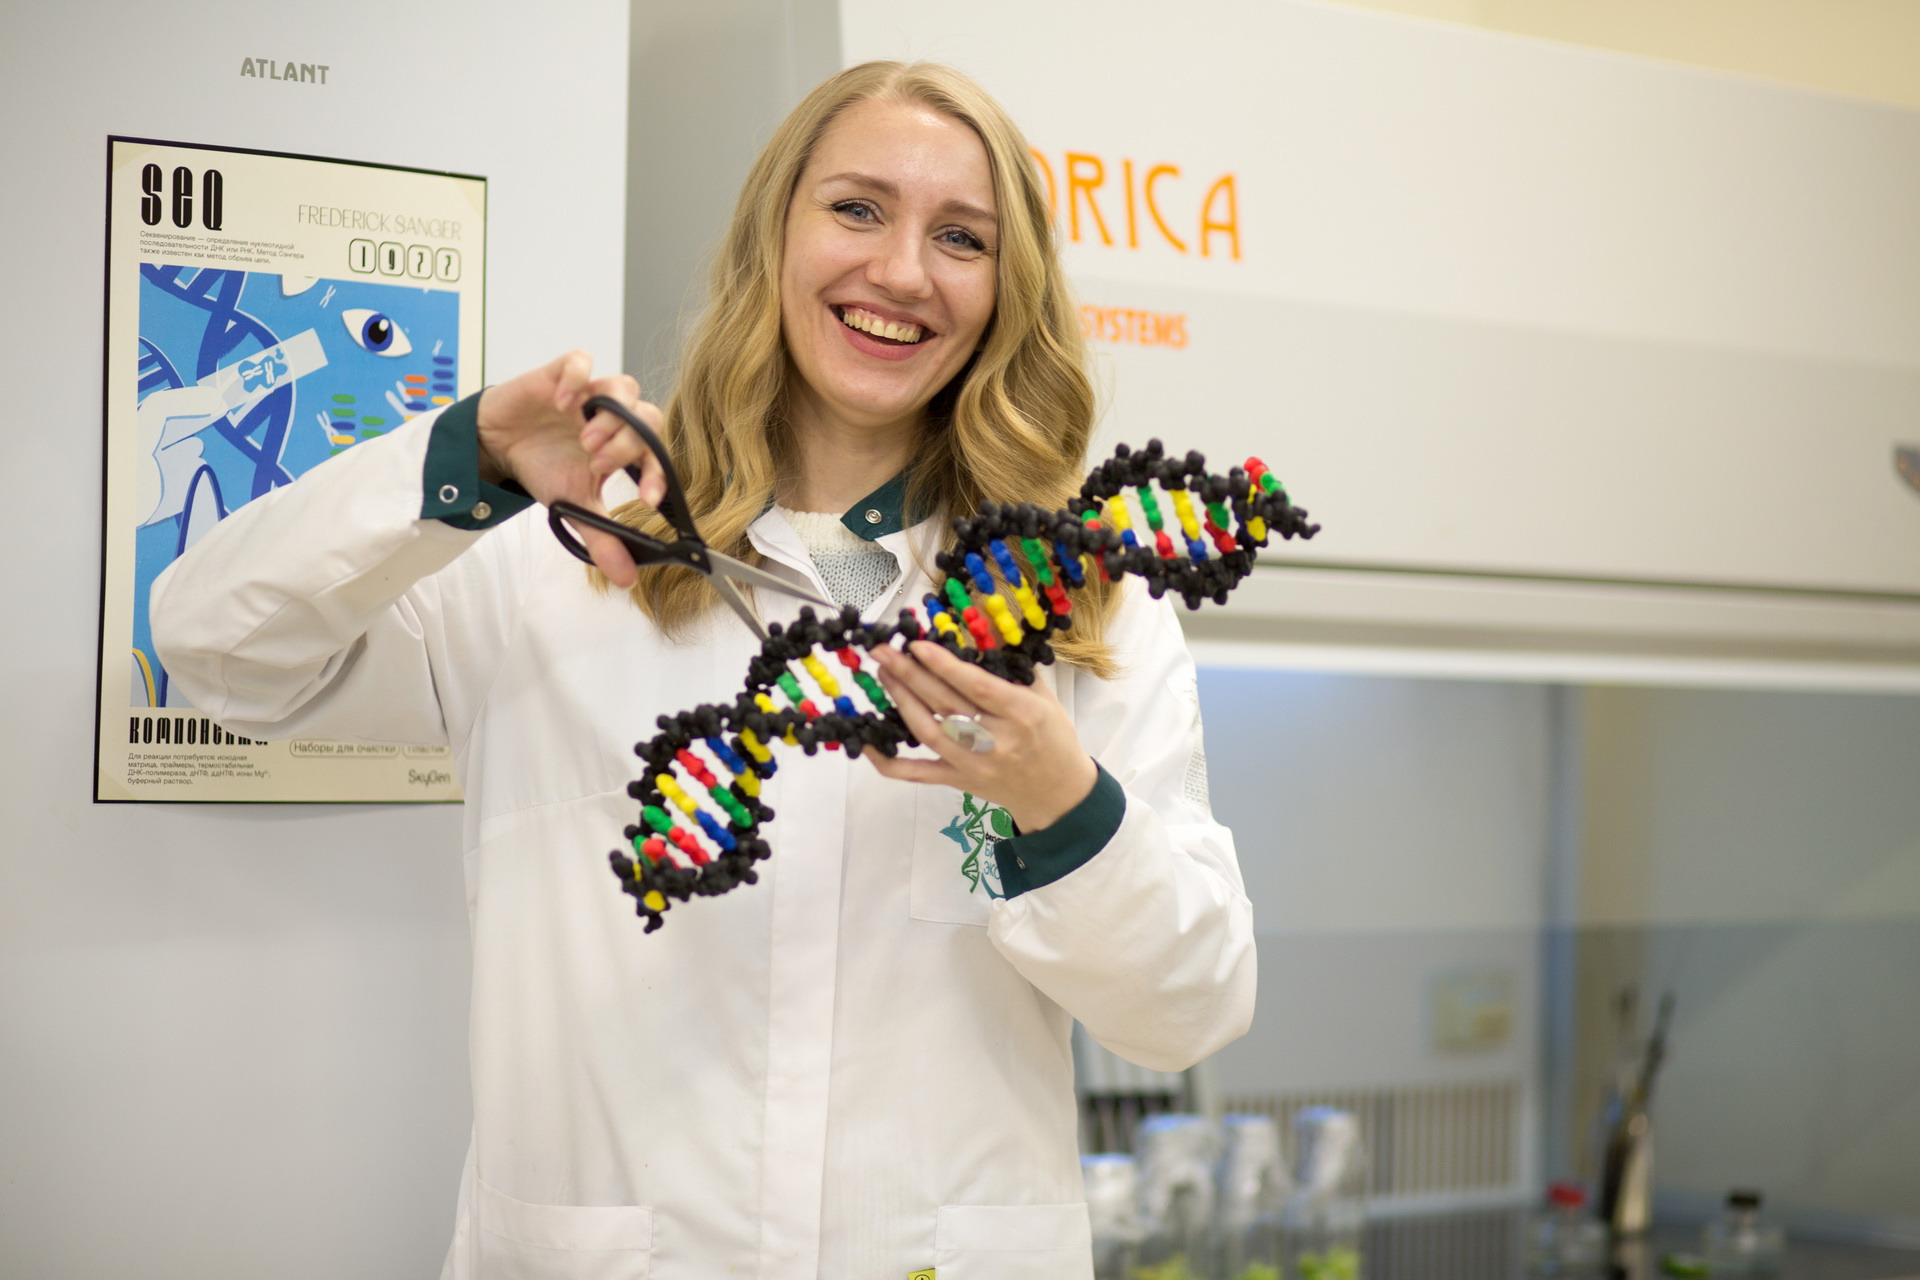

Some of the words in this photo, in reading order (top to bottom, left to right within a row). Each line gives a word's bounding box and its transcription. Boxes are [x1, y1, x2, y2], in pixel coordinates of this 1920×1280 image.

[240, 57, 330, 85] ATLANT
[298, 204, 391, 233] FREDERICK
[394, 214, 462, 240] SANGER
[140, 231, 196, 241] Секвенирование
[207, 237, 249, 246] определение
[250, 241, 295, 250] нуклеотидной
[140, 239, 209, 250] последовательности
[210, 244, 225, 252] ДНК
[256, 248, 277, 257] Метод
[278, 250, 305, 259] Сангера
[140, 247, 160, 255] также
[162, 249, 192, 257] известен
[206, 253, 227, 261] метод
[228, 254, 253, 263] обрыва
[1081, 304, 1190, 350] SYSTEMS
[128, 752, 142, 760] Для
[294, 741, 334, 754] Наборы
[336, 743, 354, 754] для
[127, 776, 162, 785] буферный
[408, 768, 452, 787] SkyGen
